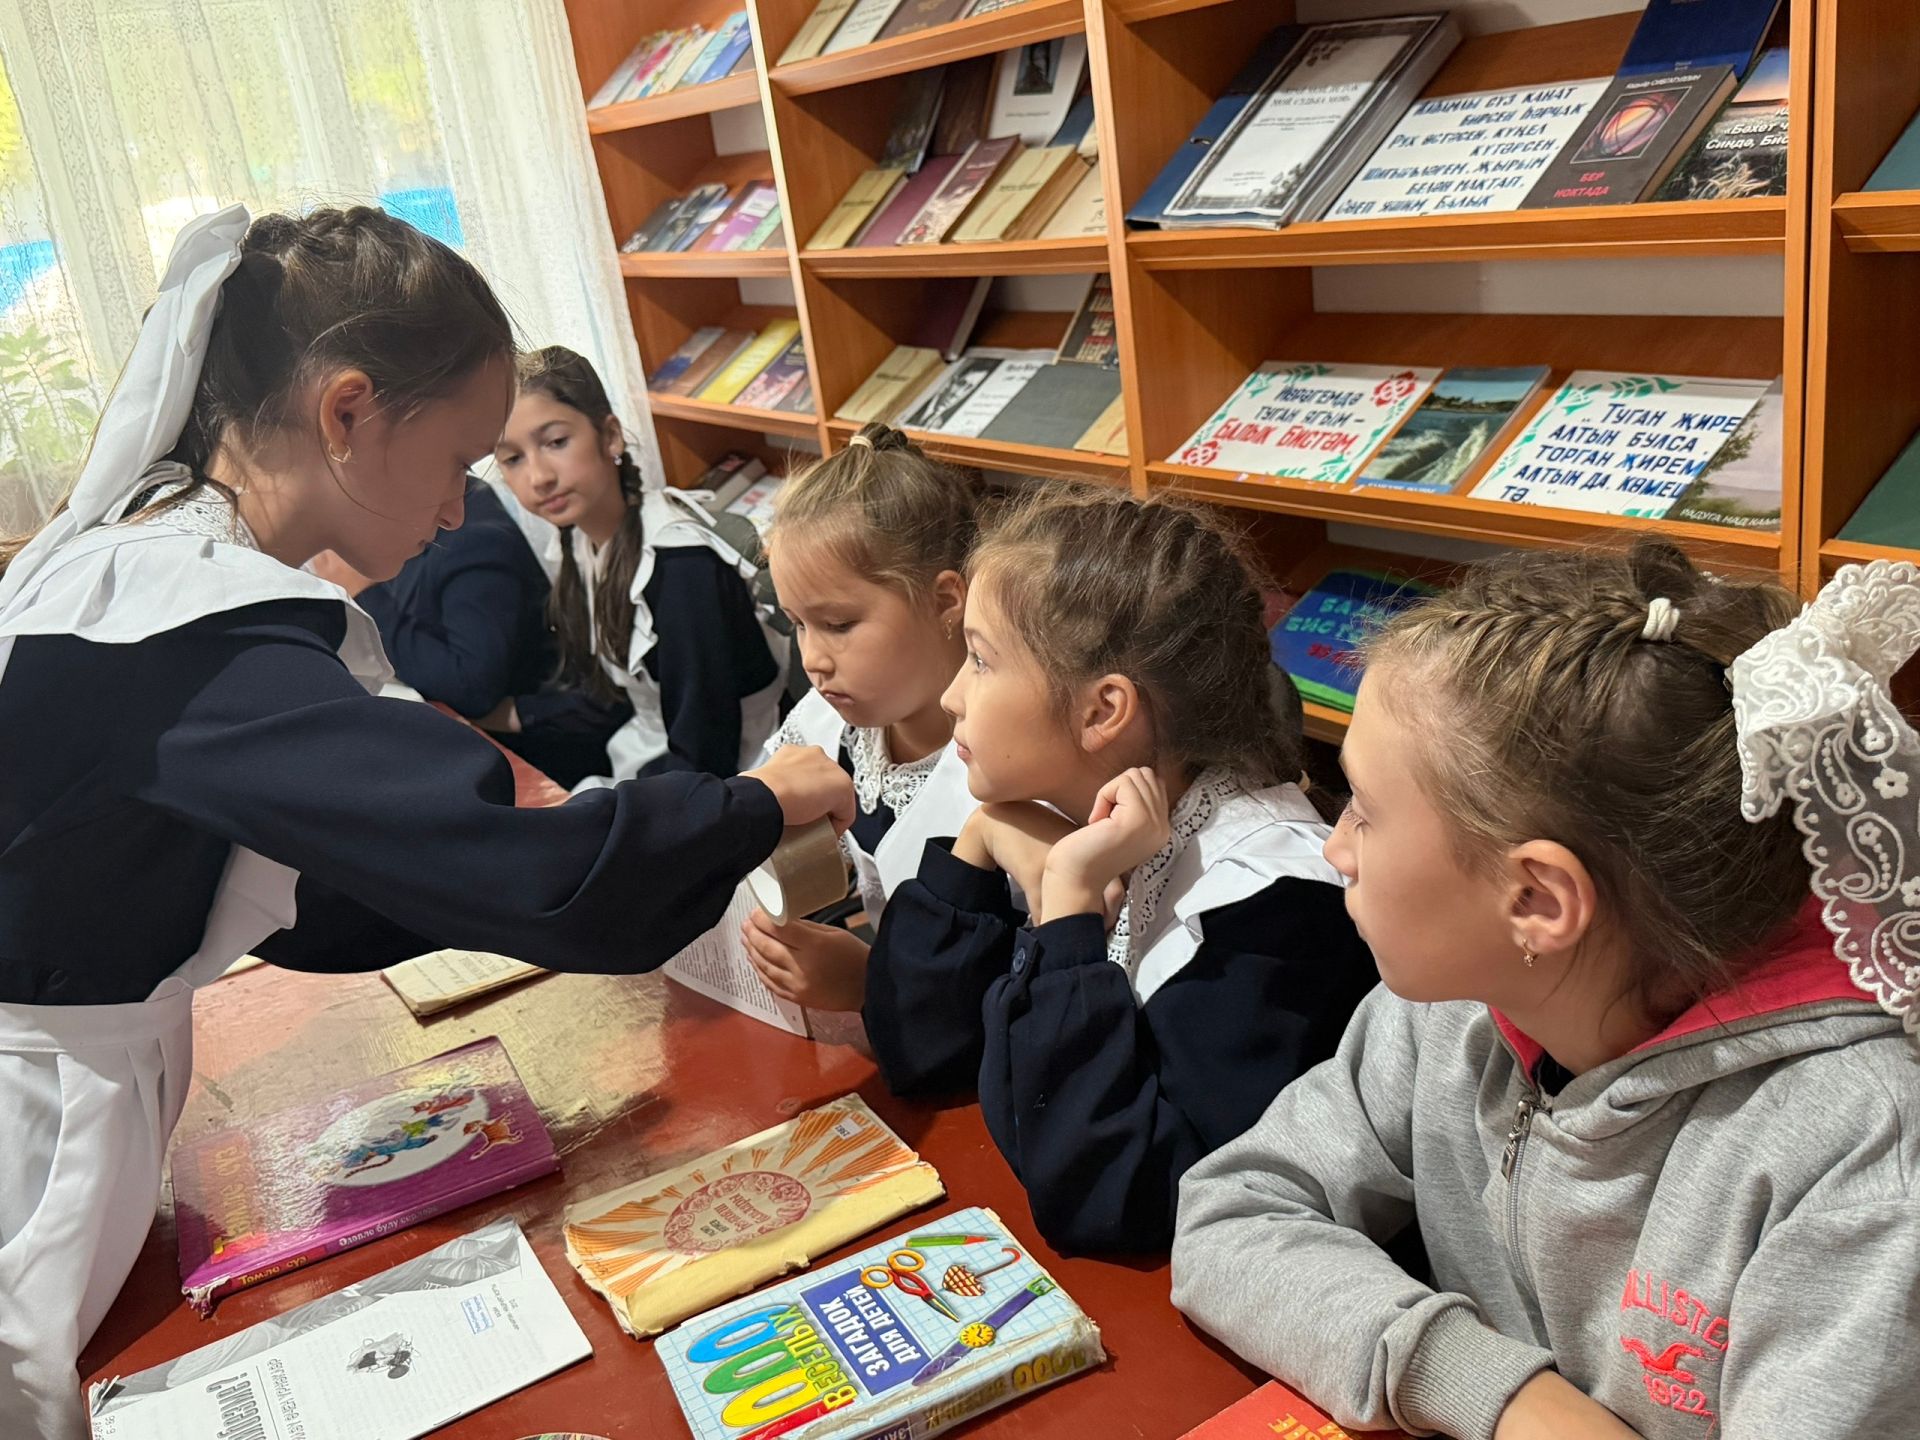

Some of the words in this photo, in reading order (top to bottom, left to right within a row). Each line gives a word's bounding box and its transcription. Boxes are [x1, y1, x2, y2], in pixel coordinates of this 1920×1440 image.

[1523, 87, 1578, 104] КАНАТ
[1578, 171, 1606, 183] БЕР
[1548, 423, 1621, 448] АЛТЫН
[1535, 444, 1616, 468] ТОРГАН
[1513, 464, 1584, 487] АЛТЫН
[1680, 508, 1722, 522] РАДУГА
[1722, 515, 1749, 527] НАД
[375, 1219, 399, 1237] булу
[844, 1284, 895, 1332] ДЕТЕЙ
[819, 1296, 891, 1377] ЗАГАДОК
[879, 1328, 922, 1364] ДЛЯ
[1642, 1374, 1714, 1418] 1922
